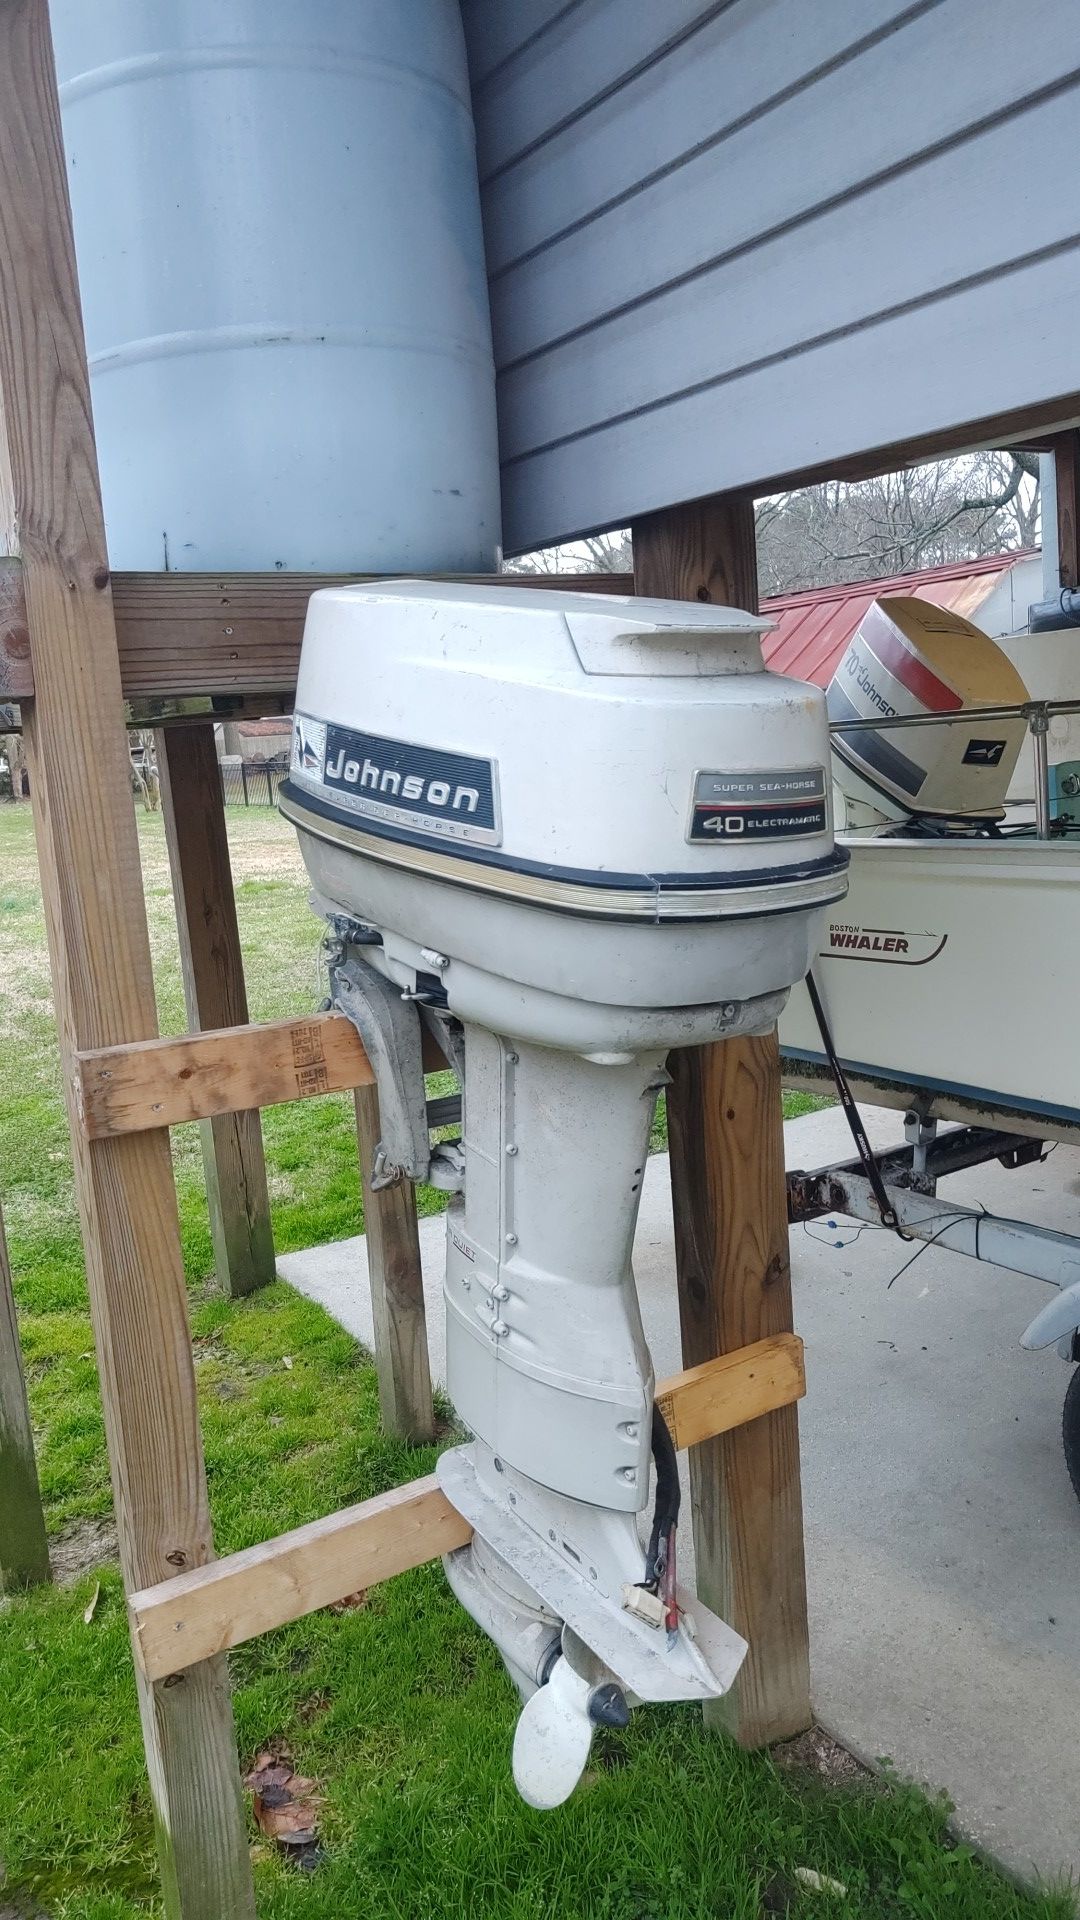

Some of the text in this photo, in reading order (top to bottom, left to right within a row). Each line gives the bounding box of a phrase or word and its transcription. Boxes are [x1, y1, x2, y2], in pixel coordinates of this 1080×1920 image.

[857, 674, 899, 716] Johnso
[326, 750, 479, 812] Johnson
[713, 780, 816, 792] SUPER SEA-HORSE
[703, 814, 821, 833] 40 ELECTRAMATIC
[829, 924, 860, 933] BOSTON
[830, 933, 909, 953] WHALER
